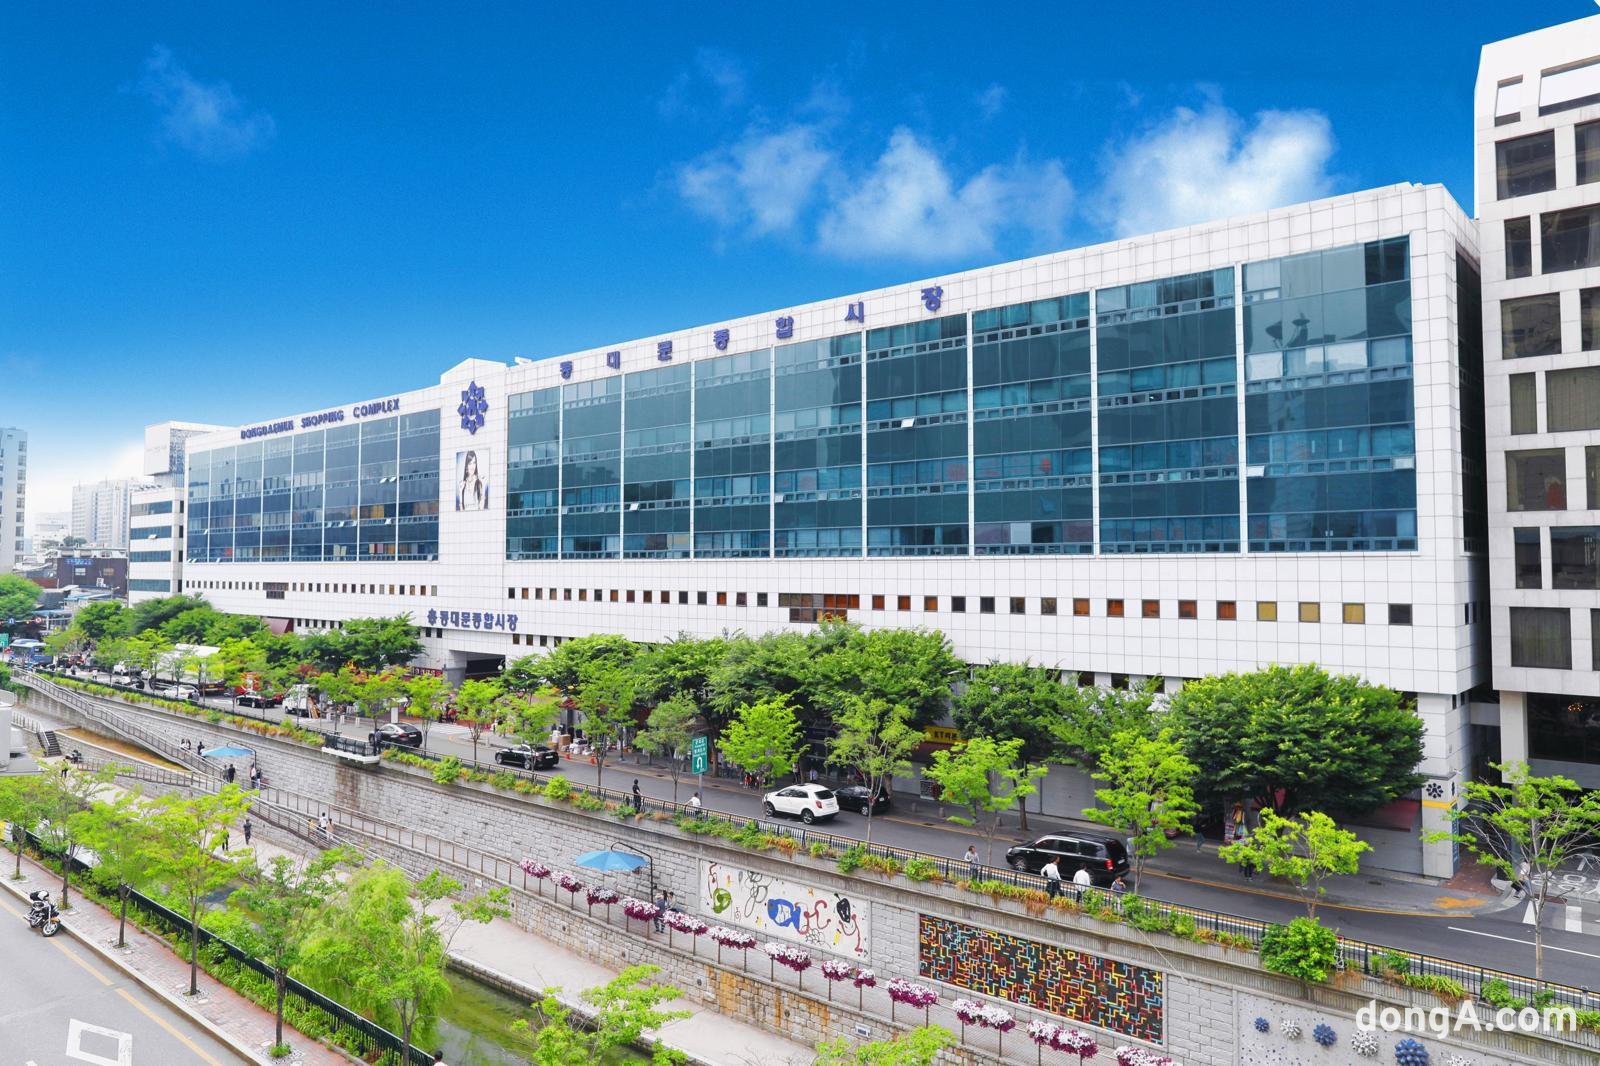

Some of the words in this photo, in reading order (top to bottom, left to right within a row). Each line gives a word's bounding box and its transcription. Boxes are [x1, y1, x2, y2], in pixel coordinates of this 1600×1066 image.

[300, 409, 344, 429] SHOPPING
[353, 398, 400, 418] COMPLEX
[439, 610, 519, 632] 동대문종합시장
